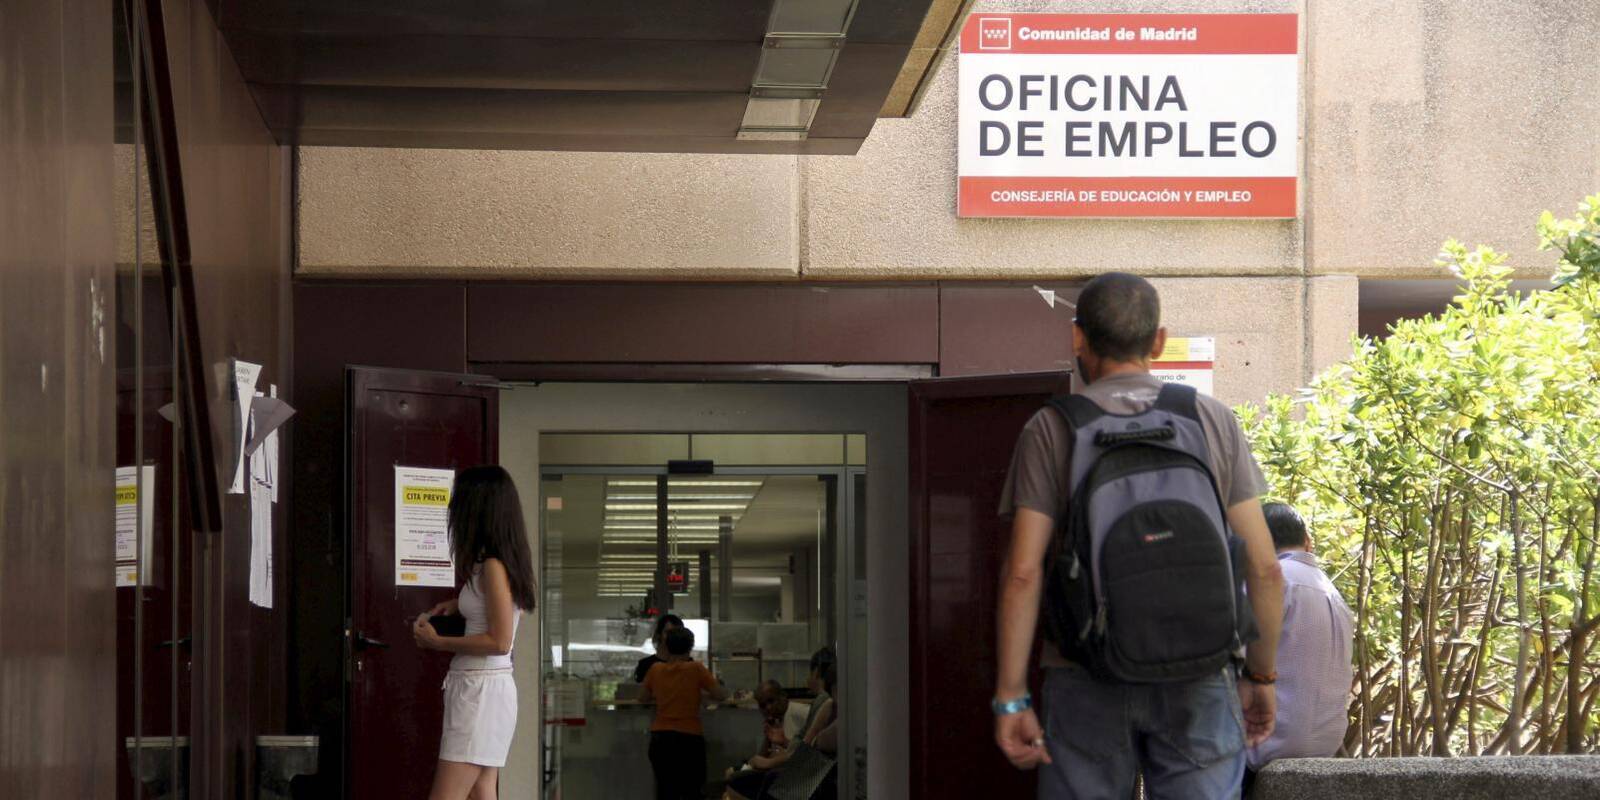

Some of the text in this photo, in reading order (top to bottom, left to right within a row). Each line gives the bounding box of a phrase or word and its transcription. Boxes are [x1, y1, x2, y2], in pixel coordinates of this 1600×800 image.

[1018, 26, 1198, 41] Comunidad de Madrid
[978, 73, 1188, 112] OFICINA
[979, 120, 1277, 158] DE EMPLEO
[991, 188, 1252, 203] CONSEJERÍA DE EDUCACIÓN Y EMPLEO
[406, 492, 447, 502] CITA PREVIA
